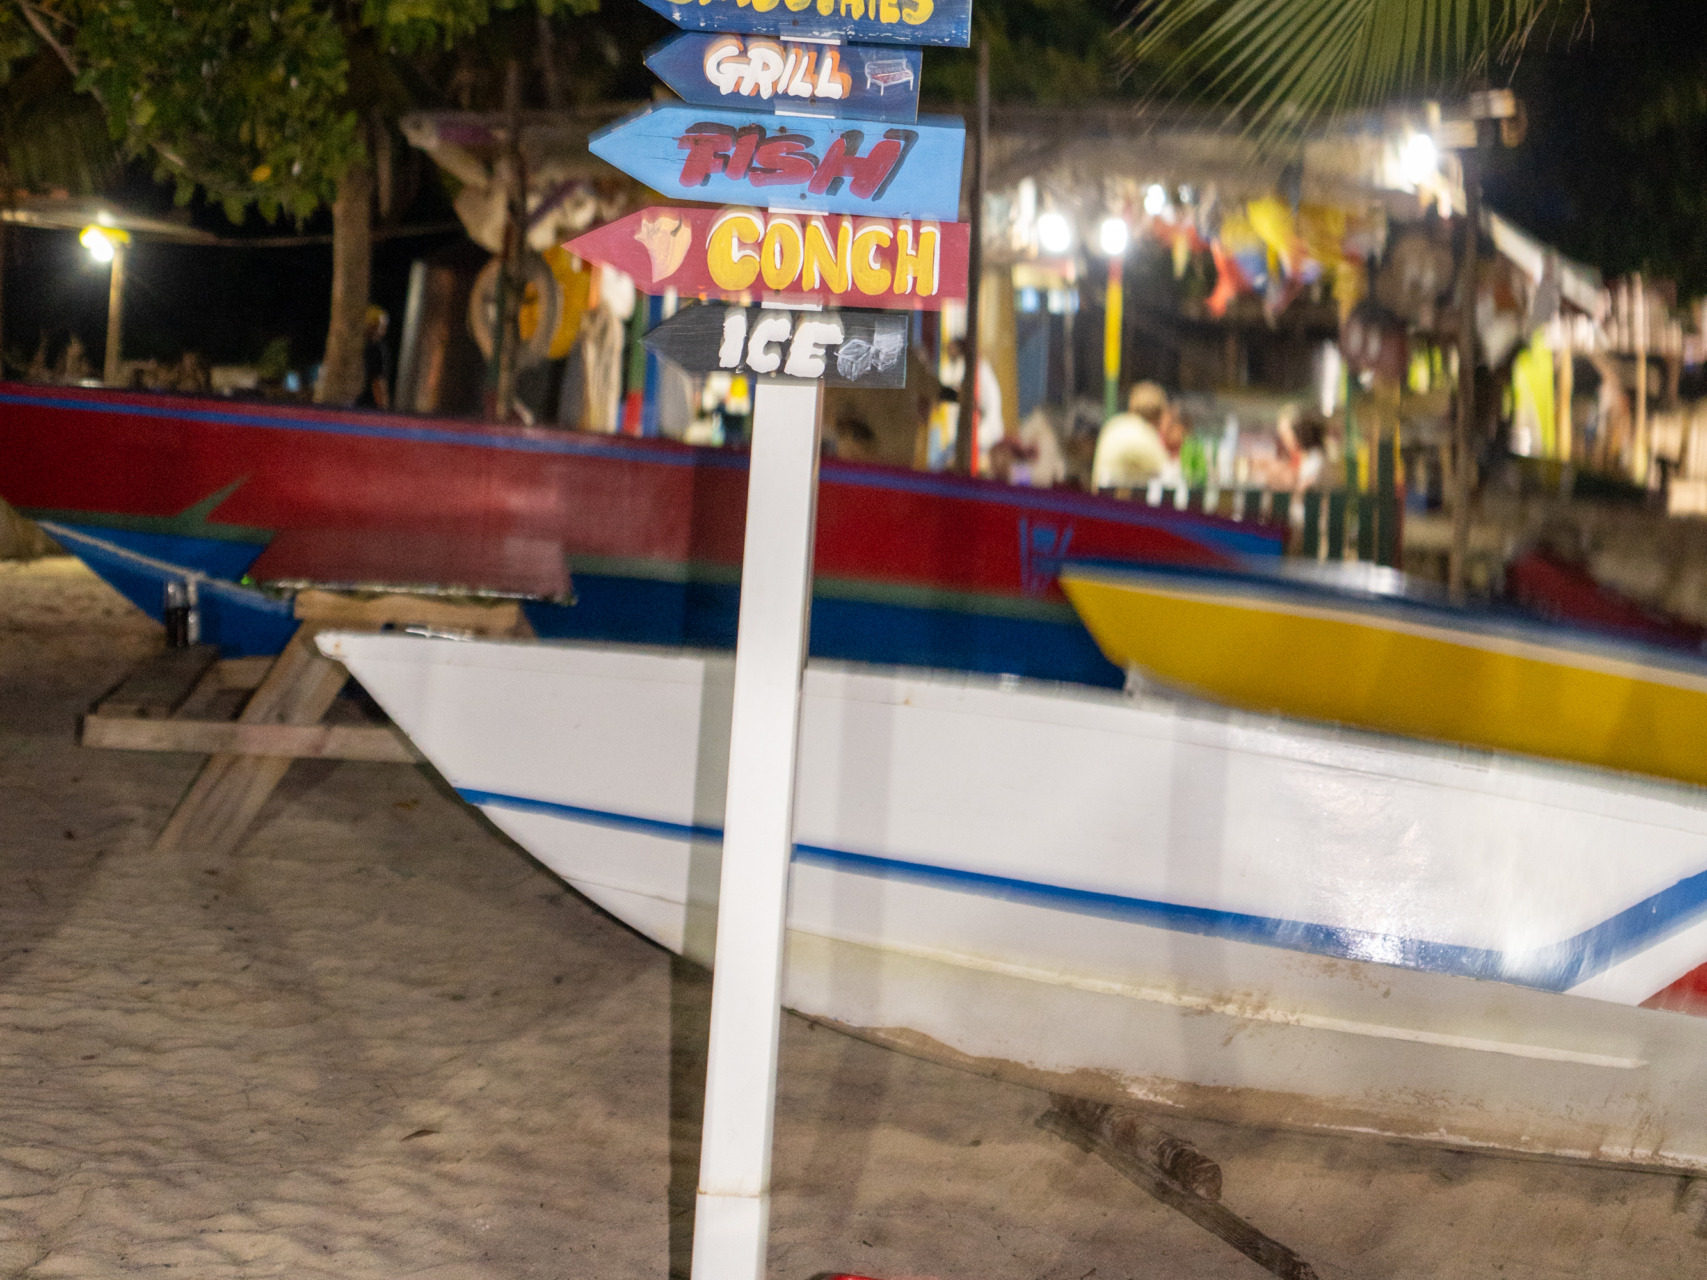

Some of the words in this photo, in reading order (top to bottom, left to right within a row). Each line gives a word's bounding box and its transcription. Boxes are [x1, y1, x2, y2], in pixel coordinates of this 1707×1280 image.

[703, 36, 852, 99] GRILL
[676, 122, 919, 201] FISH
[706, 211, 941, 297] CONCH
[718, 312, 844, 378] ICE
